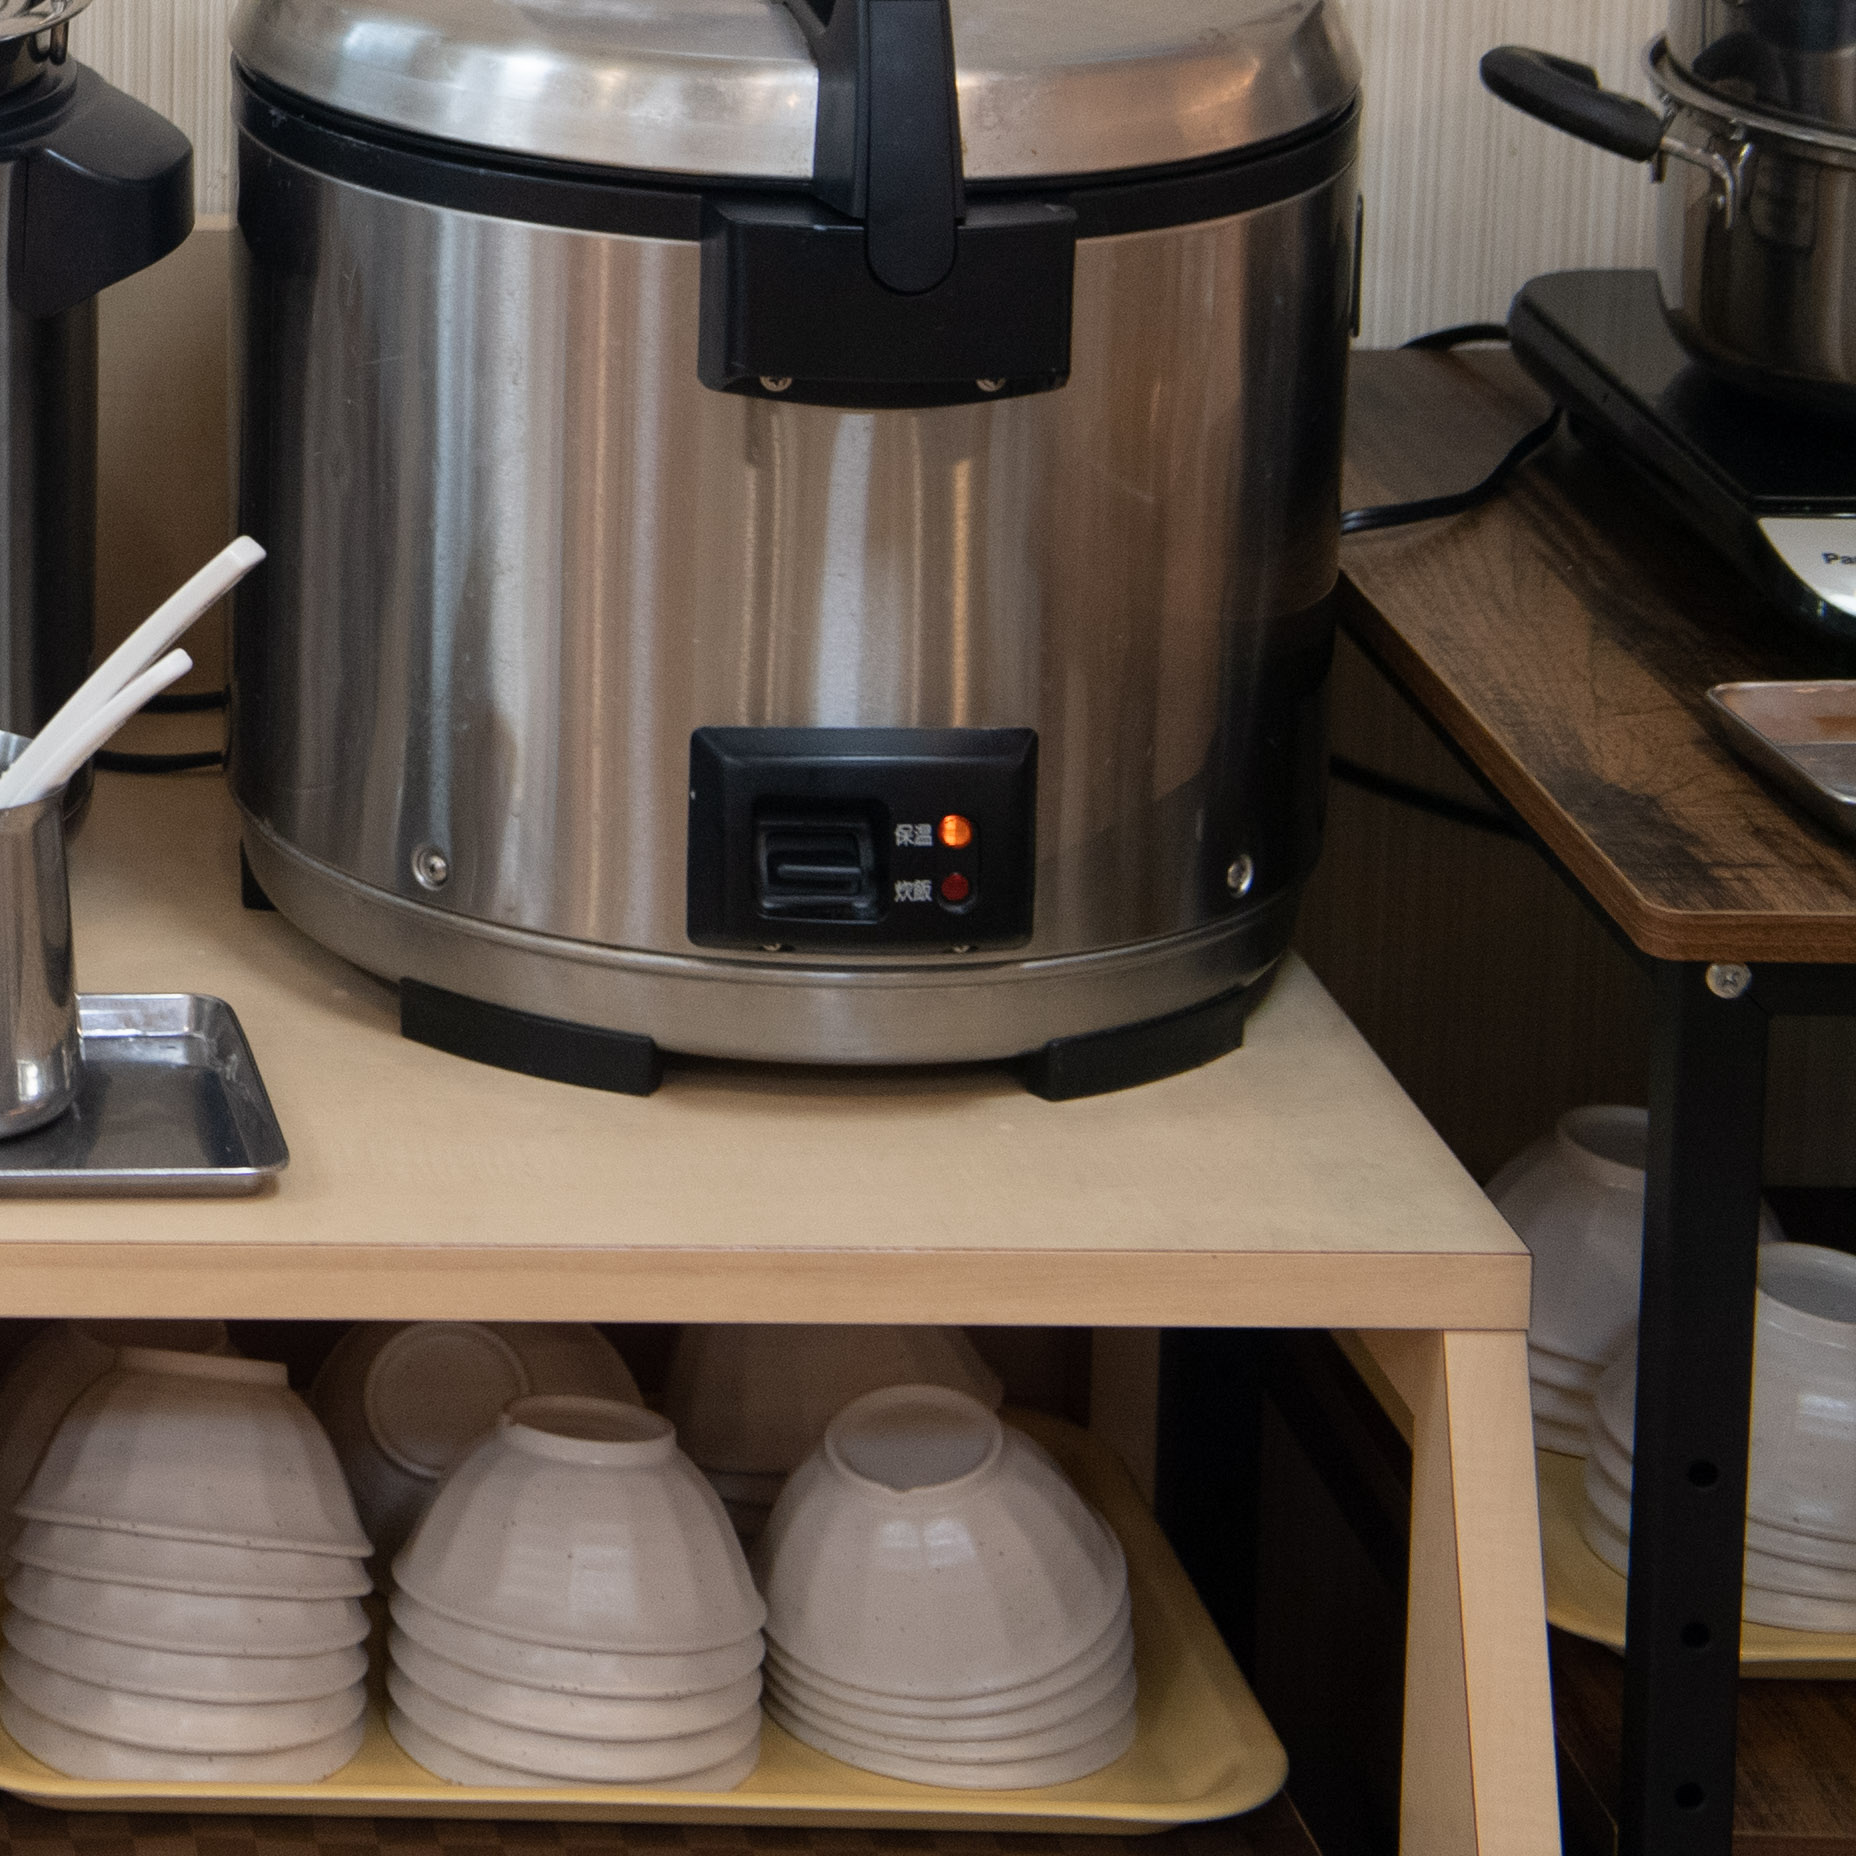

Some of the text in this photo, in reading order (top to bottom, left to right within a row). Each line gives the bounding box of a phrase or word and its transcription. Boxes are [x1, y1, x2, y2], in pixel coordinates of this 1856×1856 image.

[1821, 552, 1856, 564] Pa
[894, 823, 933, 847] 保温
[894, 879, 933, 903] 炊飯
